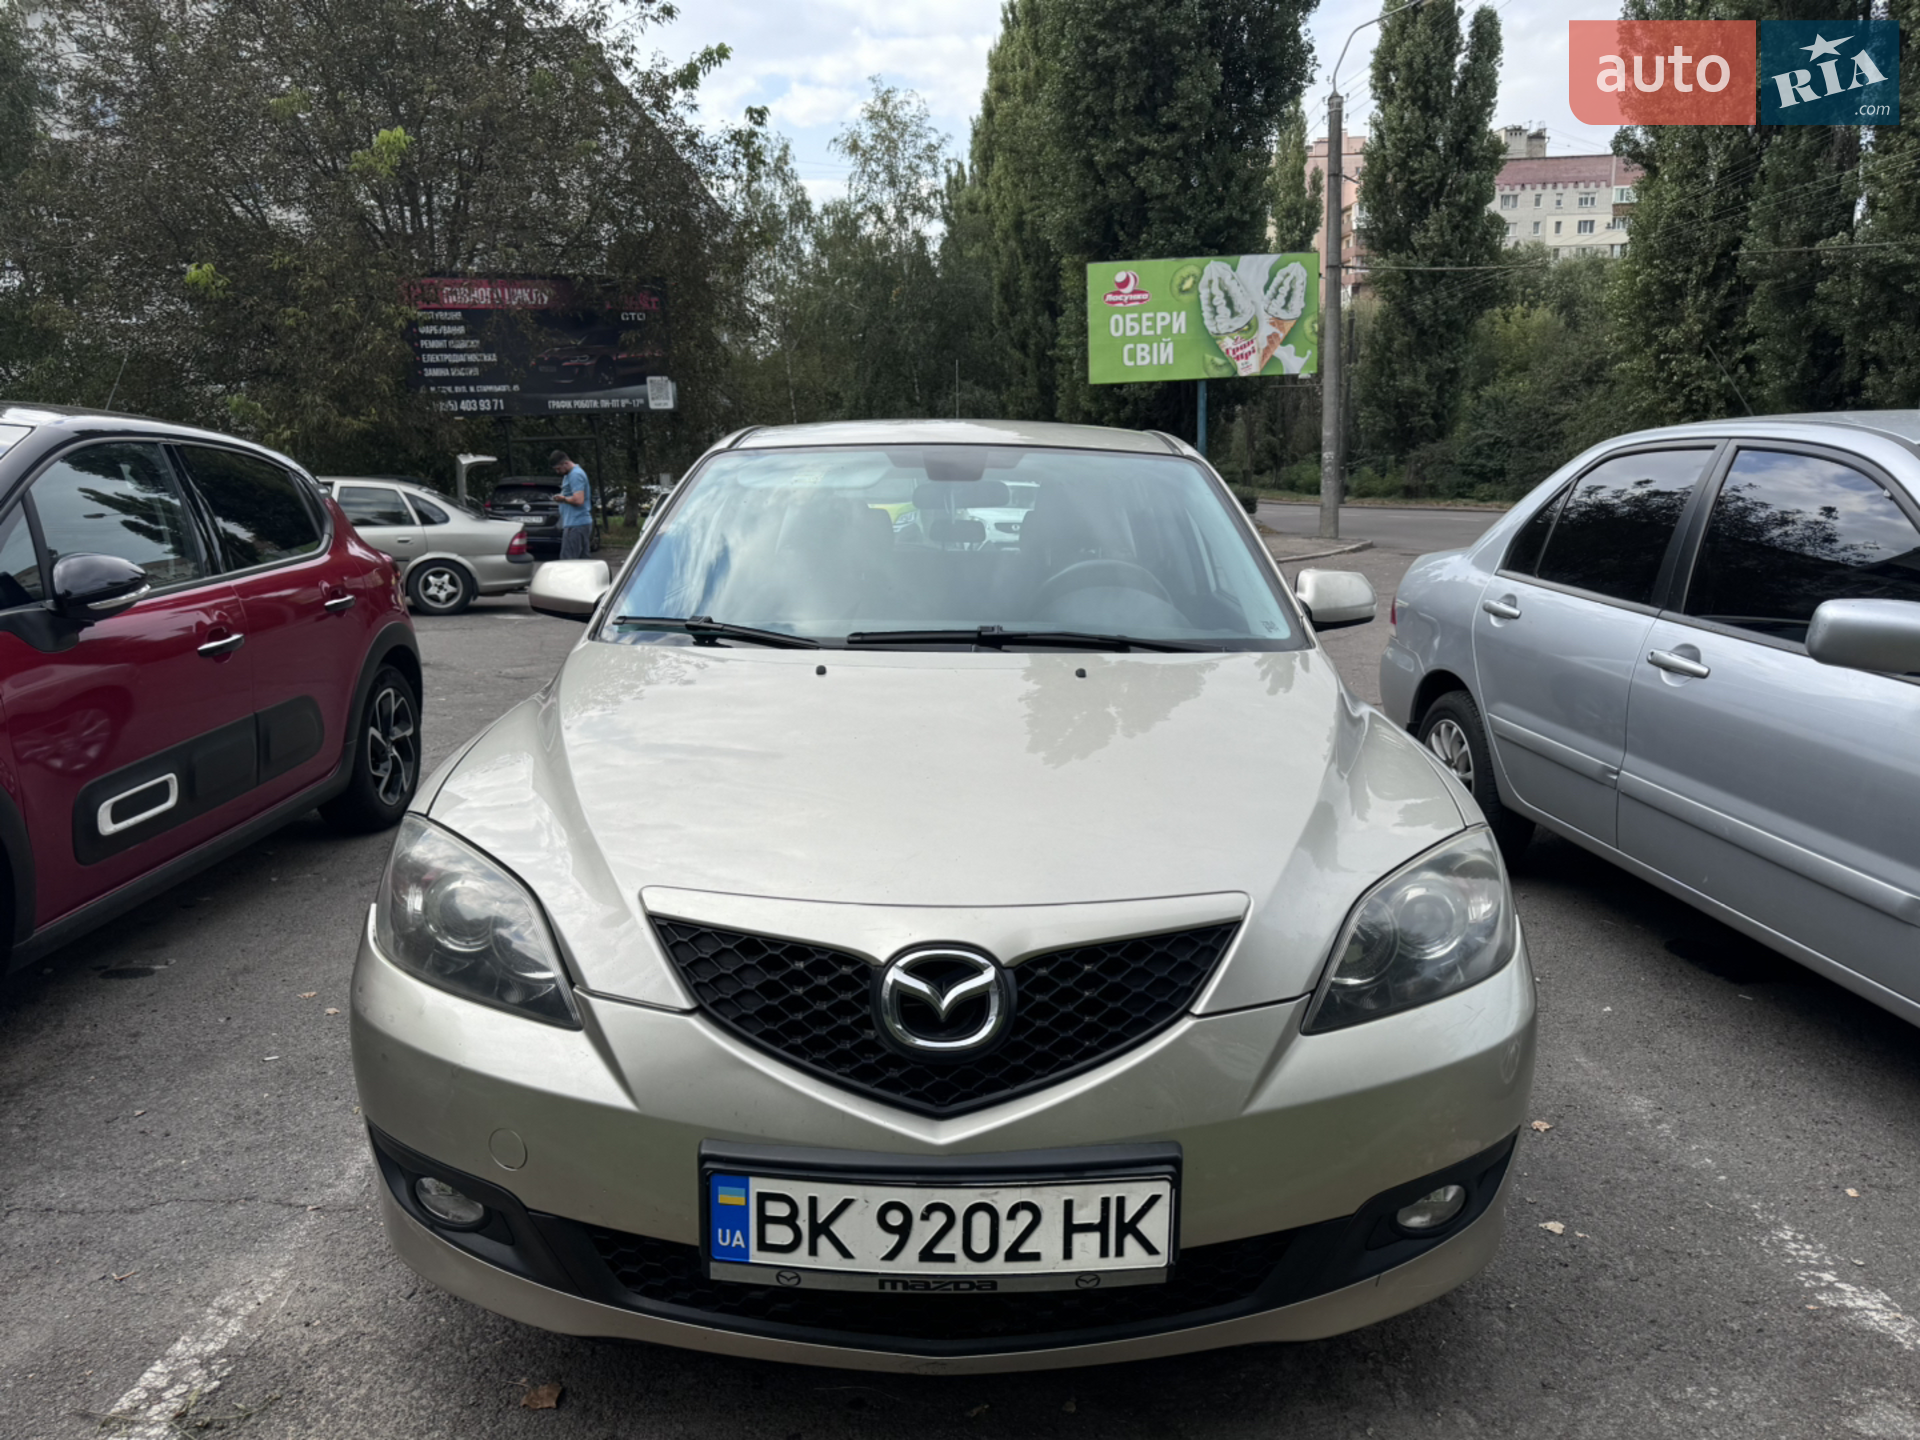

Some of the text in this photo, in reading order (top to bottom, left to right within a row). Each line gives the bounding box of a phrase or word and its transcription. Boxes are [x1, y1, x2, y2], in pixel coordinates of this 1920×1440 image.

[1109, 311, 1187, 337] ОБЕРИ
[420, 339, 447, 349] РЕМОНТ
[1122, 338, 1174, 366] СВІЙ
[460, 399, 478, 411] 403
[479, 399, 491, 411] 93
[492, 398, 504, 411] 71
[755, 1191, 1163, 1263] BK 9202 HK
[718, 1229, 746, 1249] UA
